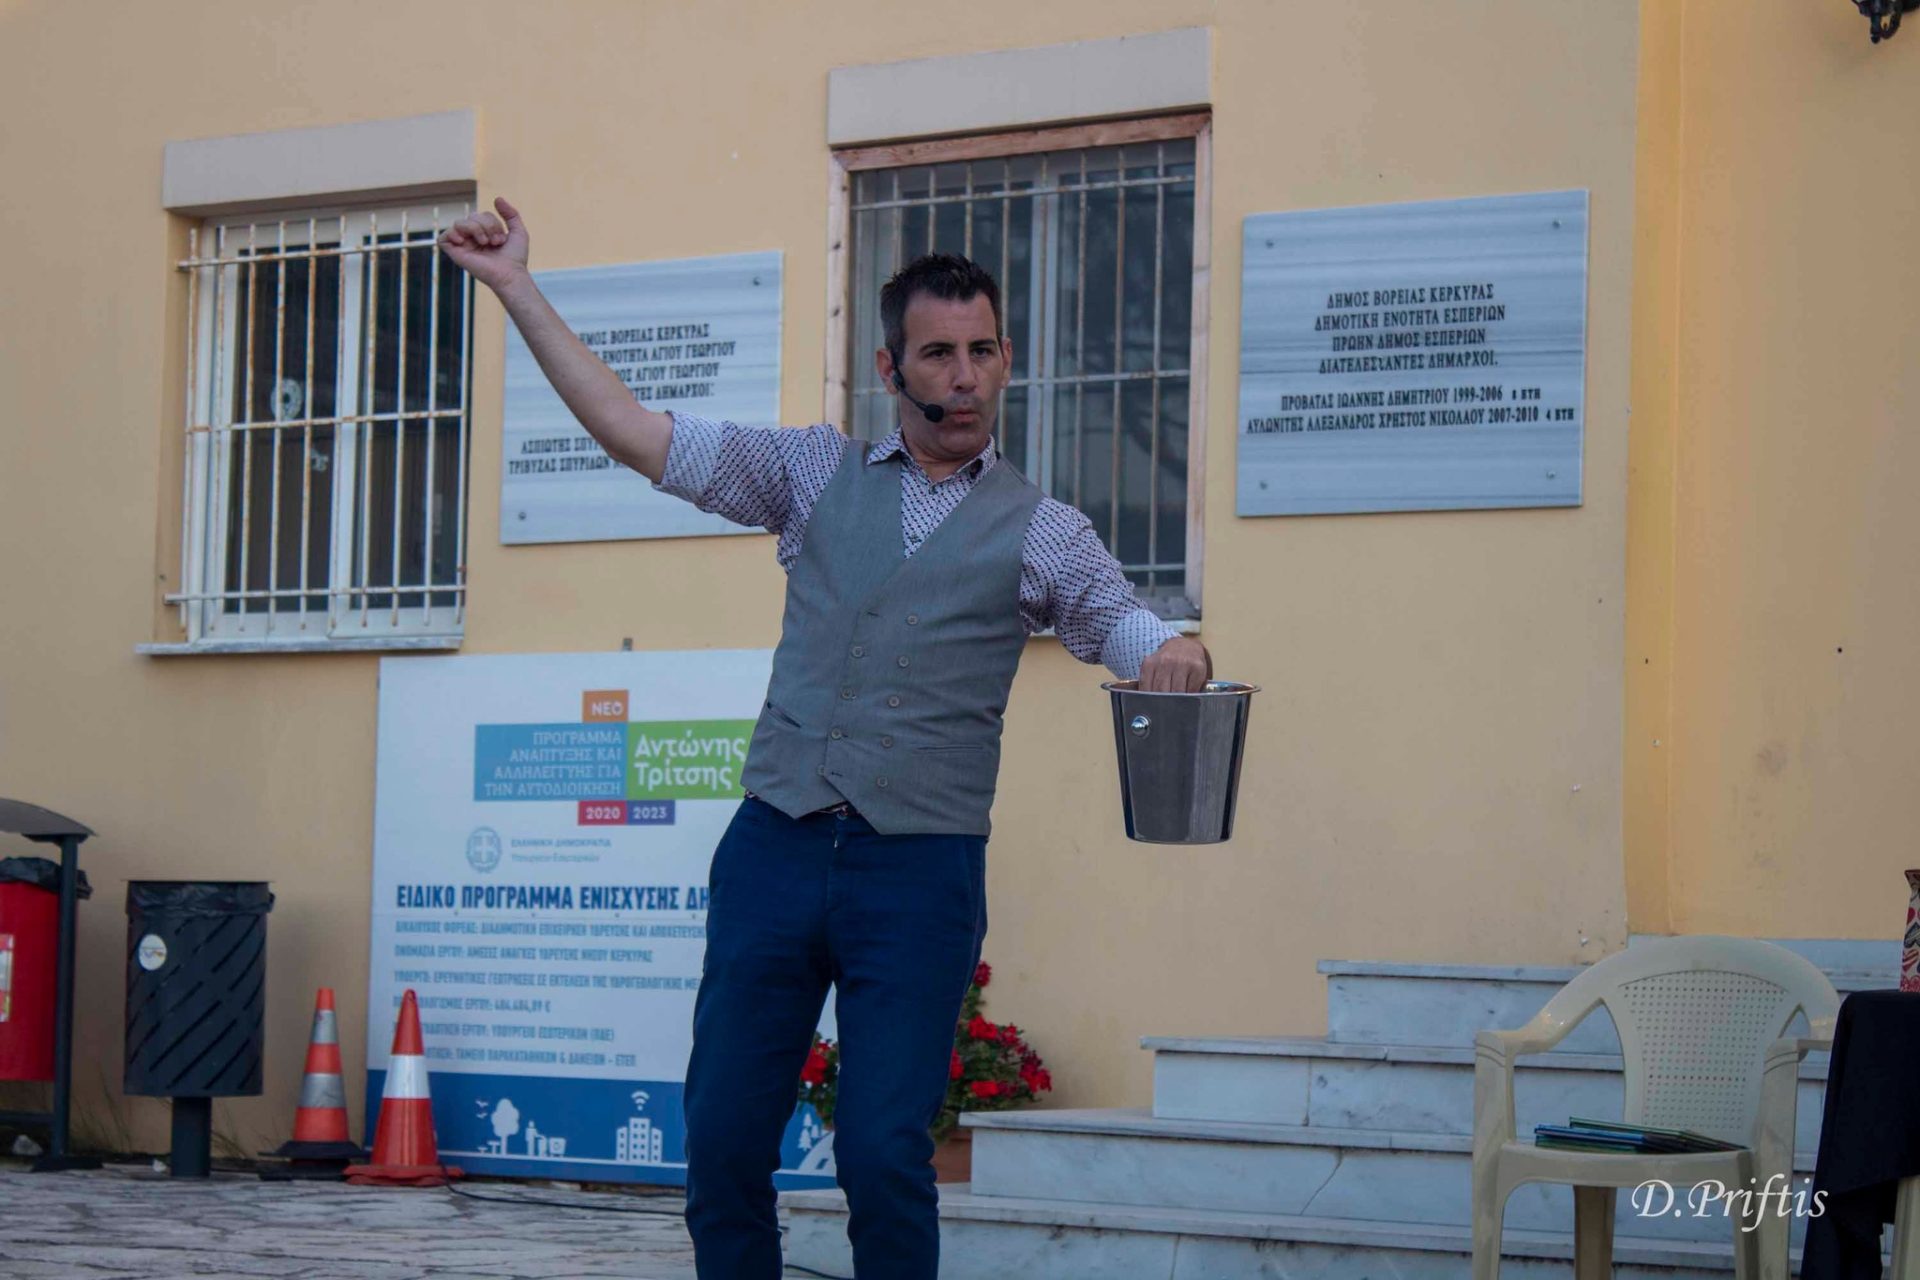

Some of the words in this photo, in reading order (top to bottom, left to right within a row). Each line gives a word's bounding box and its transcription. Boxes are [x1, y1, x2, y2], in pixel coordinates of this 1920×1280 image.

[1327, 292, 1369, 309] ΔΗΜΟΣ
[1373, 288, 1426, 306] ΒΟΡΕΙΑΣ
[1430, 284, 1494, 303] ΚΕΡΚΥΡΑΣ
[1314, 313, 1379, 331] ΔΗΜΟΤΙΚΗ
[1383, 310, 1439, 327] ΕΝΟΤΗΤΑ
[1444, 305, 1506, 324] ΕΣΠΕΡΙΩΝ
[580, 331, 607, 346] ΗΜΟΣ
[610, 327, 654, 345] ΒΟΡΕΙΑΣ
[656, 323, 710, 341] ΚΕΡΚΥΡΑΣ
[1332, 335, 1373, 352] ΠΡΩΗΝ
[1377, 332, 1420, 349] ΔΗΜΟΣ
[1424, 328, 1486, 347] ΕΣΠΕΡΙΩΝ
[650, 345, 684, 362] ΑΓΙΟΥ
[685, 341, 736, 359] ΓΕΩΡΓΙΟΥ
[635, 364, 667, 383] ΑΓΙΟΥ
[669, 362, 720, 380] ΓΕΩΡΓΙΟΥ
[1281, 393, 1334, 411] ΠΡΟΒΑΤΑΣ
[1337, 391, 1385, 409] ΙΩΑΝΝΗΣ
[1387, 388, 1450, 406] ΔΗΜΗΤΡΙΟΥ
[1453, 385, 1503, 403] 1999-2006
[1246, 416, 1304, 434] ΑΥΛΩΝΙΤΗΣ
[1307, 413, 1375, 432] ΑΛΕΞΑΝΔΡΟΣ
[1378, 411, 1426, 428] ΧΡΗΣΤΟΣ
[1429, 408, 1485, 426] ΝΙΚΟΛΑΟΥ
[1488, 405, 1539, 424] 2007-2010
[591, 702, 624, 716] ΝΕΟ
[533, 732, 622, 746] ΠΡΟΓΡΑΜΜΑ
[634, 729, 747, 763] Αντώνης
[509, 748, 593, 763] ΑΝΑΠΤΥΞΗΣ
[597, 748, 621, 761] ΚΑΙ
[494, 765, 594, 779] ΑΛΛΗΛΕΓΓΥΗΣ
[598, 765, 621, 778] ΓΙΑ
[633, 758, 733, 792] Τρίτσης
[485, 783, 513, 797] ΤΗΝ
[517, 782, 621, 796] ΑΥΤΟΔΙΟΙΚΗΣΗ
[586, 807, 621, 820] 2020
[632, 806, 667, 819] 2023
[396, 884, 455, 908] ΕΙΔΙΚΟ
[461, 885, 574, 909] ΠΡΟΓΡΑΜΜΑ
[580, 886, 680, 910] ΕΝΙΣΧΥΣΗΣ
[685, 887, 710, 910] ΔΗ
